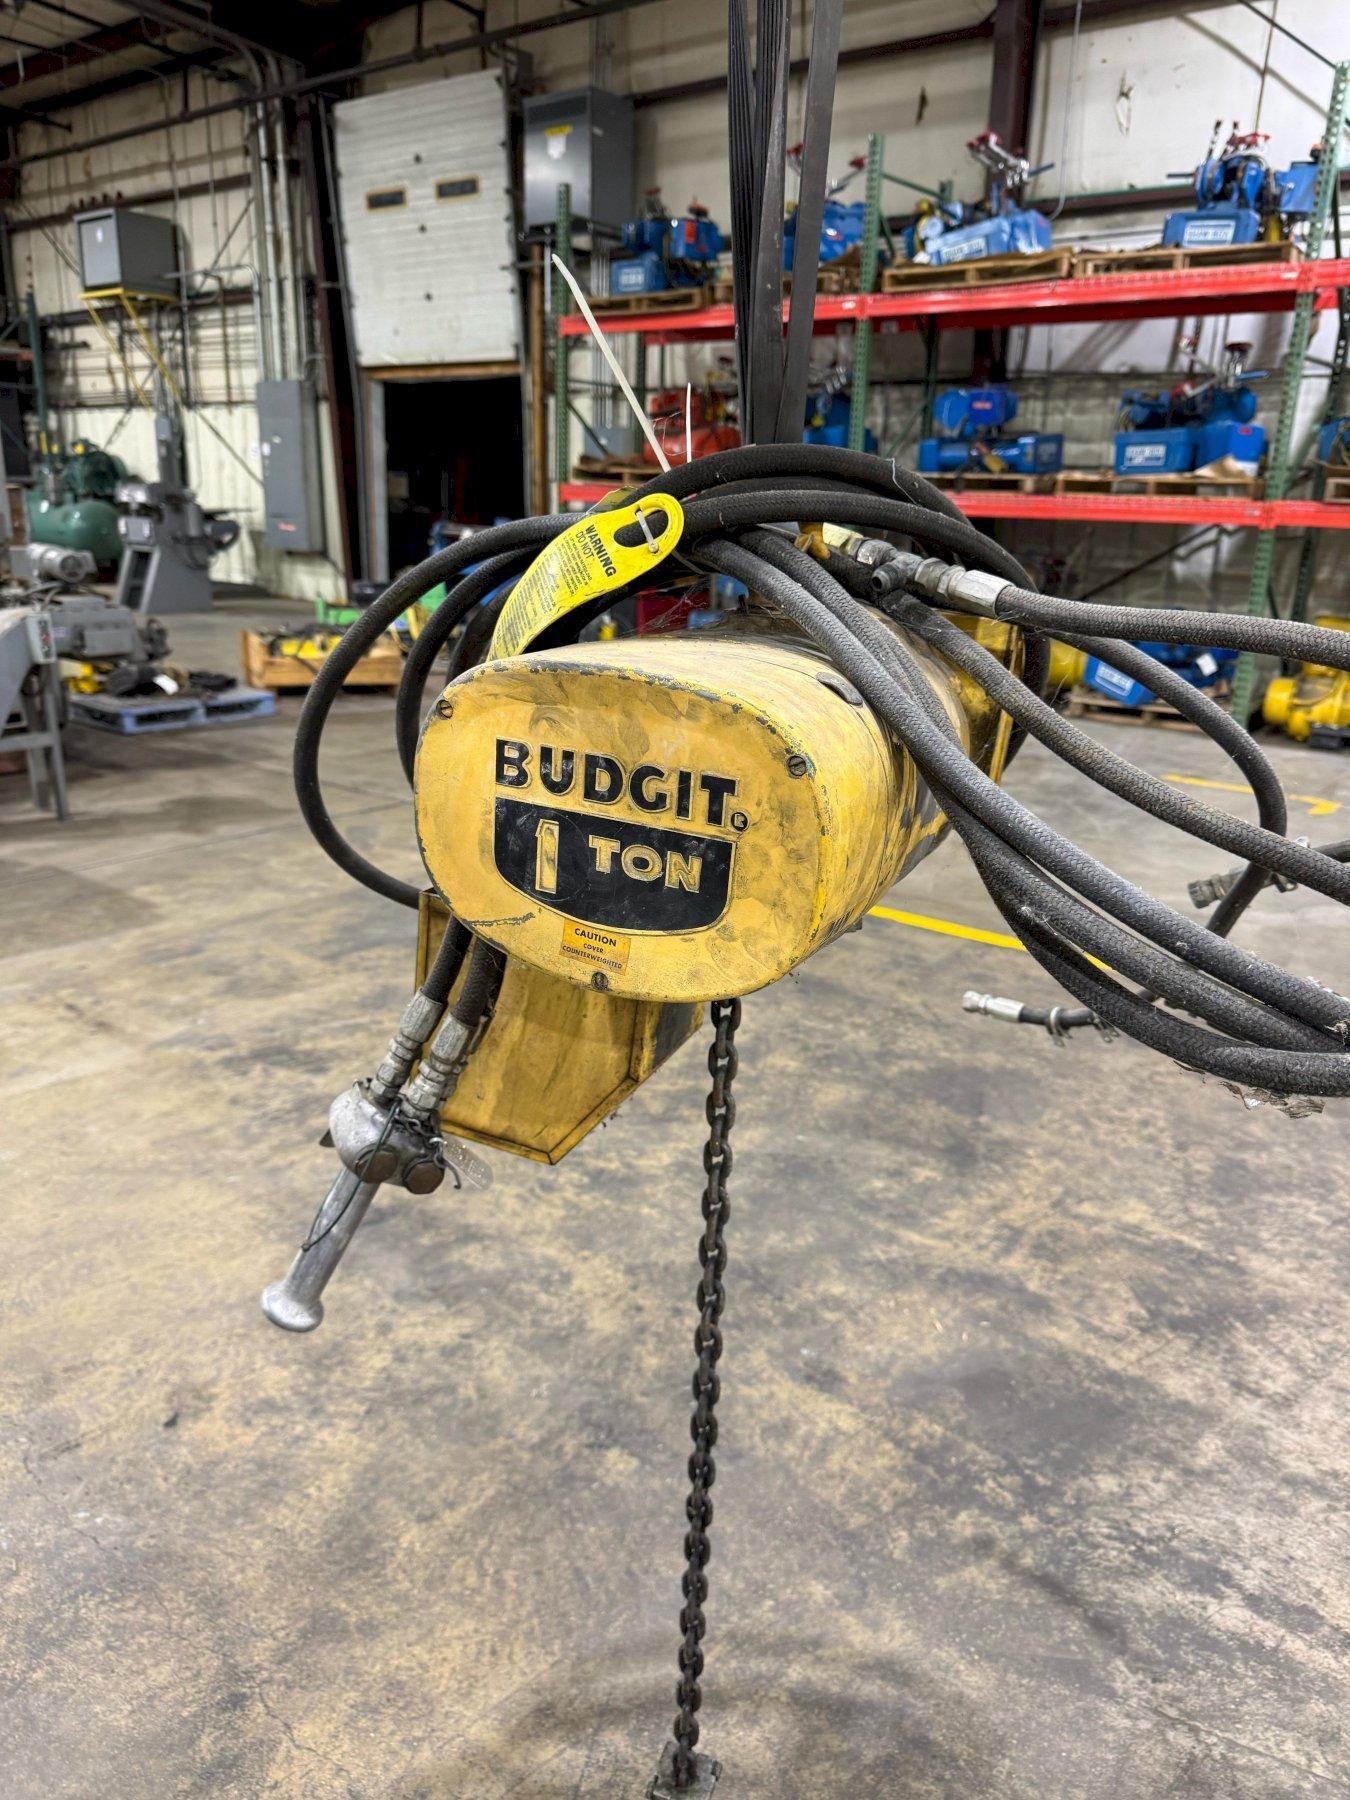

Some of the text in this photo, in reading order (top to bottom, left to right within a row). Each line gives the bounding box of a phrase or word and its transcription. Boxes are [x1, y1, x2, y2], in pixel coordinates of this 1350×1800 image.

[576, 531, 595, 559] DO NOT
[585, 524, 617, 577] WARNING
[495, 738, 738, 828] BUDGIT
[535, 818, 703, 894] 1 TON
[574, 927, 617, 947] CAUTION
[583, 943, 604, 954] COVER
[562, 945, 623, 969] COUNTERWEIGHTED
